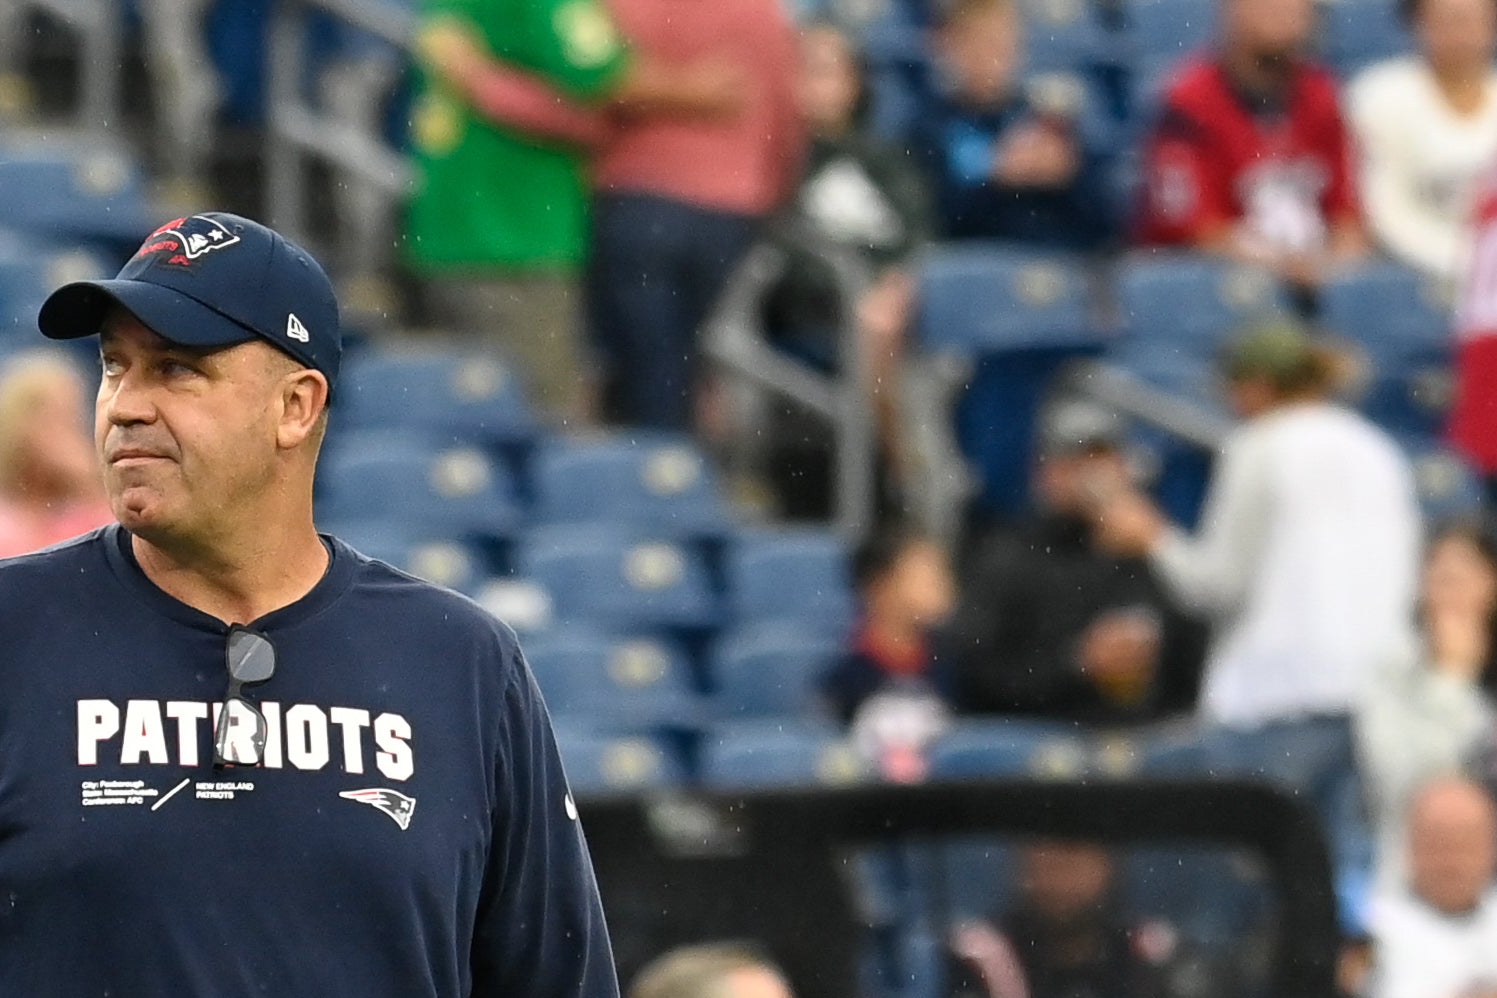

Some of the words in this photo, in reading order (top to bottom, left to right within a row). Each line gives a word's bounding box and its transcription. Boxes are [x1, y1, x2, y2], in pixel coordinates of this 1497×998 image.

[77, 699, 415, 781] PATRIOTS
[195, 782, 214, 790] NEW
[215, 782, 255, 791] ENGLAND
